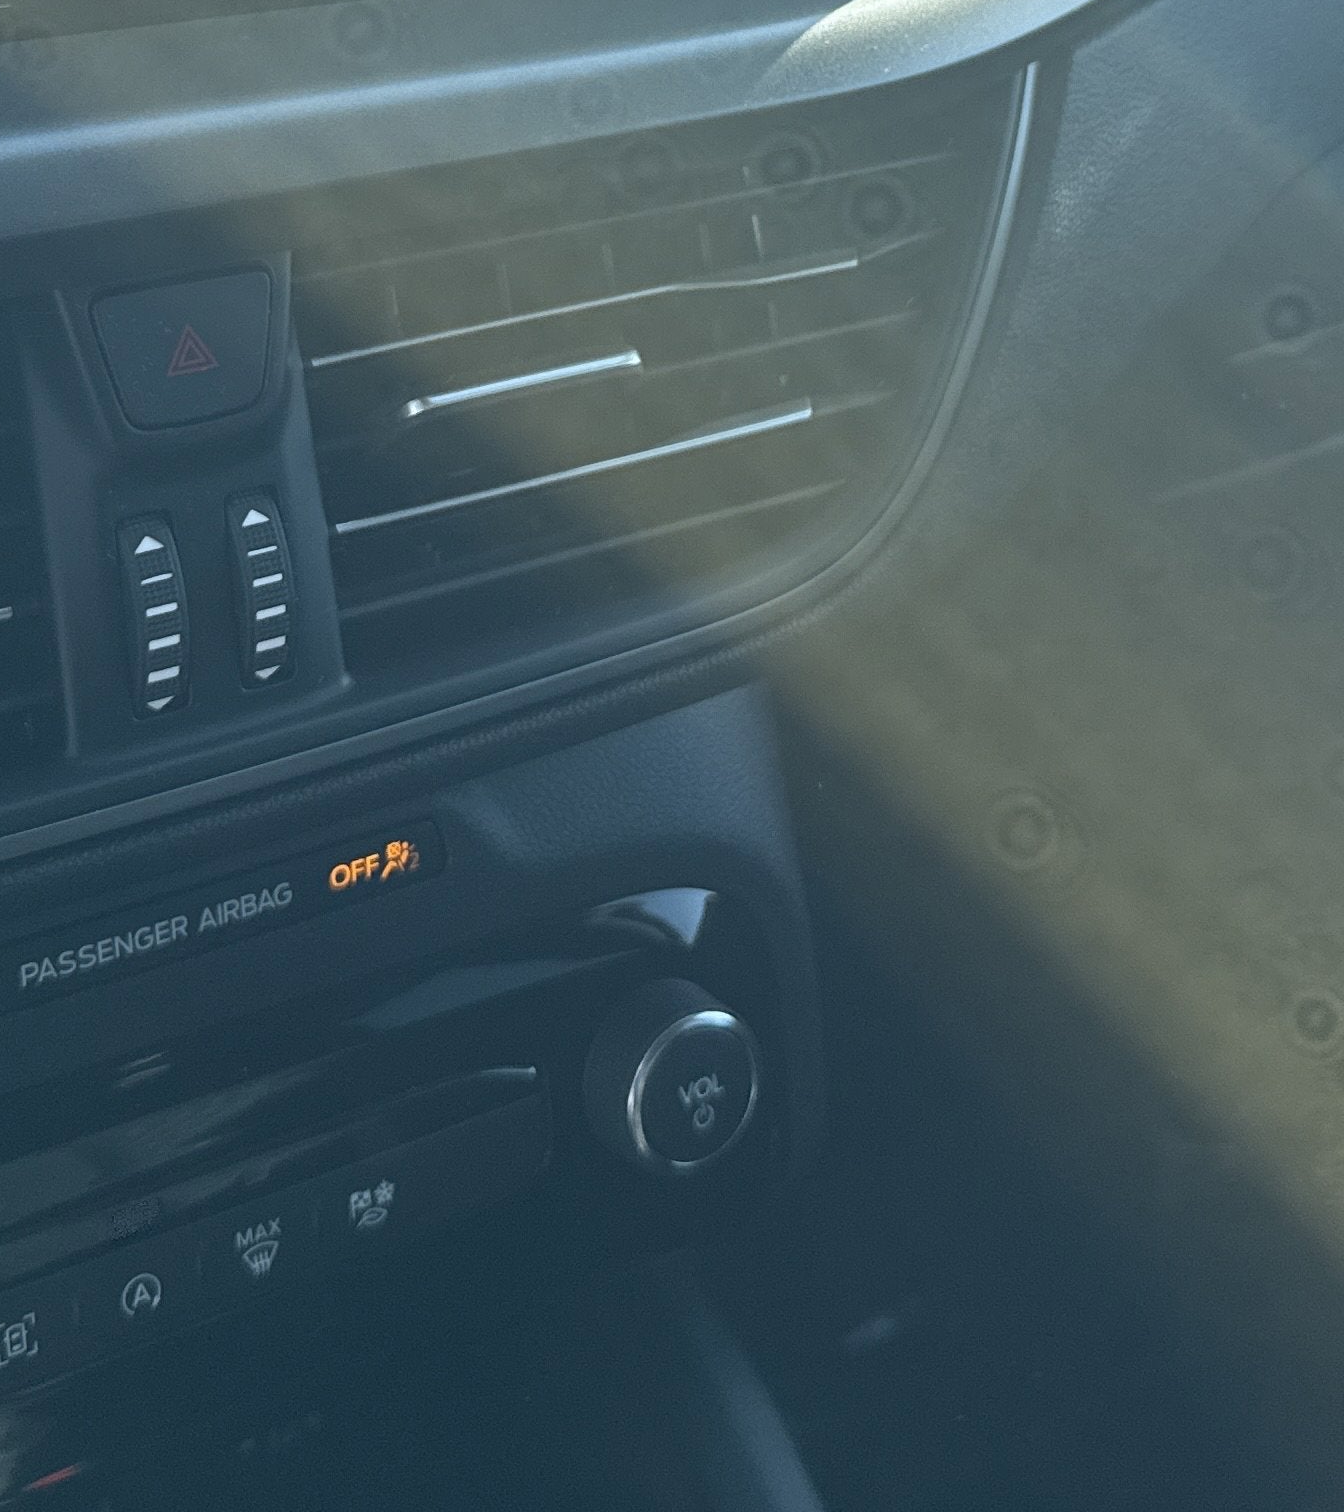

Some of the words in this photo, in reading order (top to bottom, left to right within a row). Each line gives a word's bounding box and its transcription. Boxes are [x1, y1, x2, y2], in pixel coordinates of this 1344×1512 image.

[329, 852, 381, 892] OFF
[20, 916, 188, 988] PASSENGER
[199, 882, 294, 934] AIRBAG
[678, 1073, 725, 1109] VOL
[236, 1218, 282, 1251] MAX
